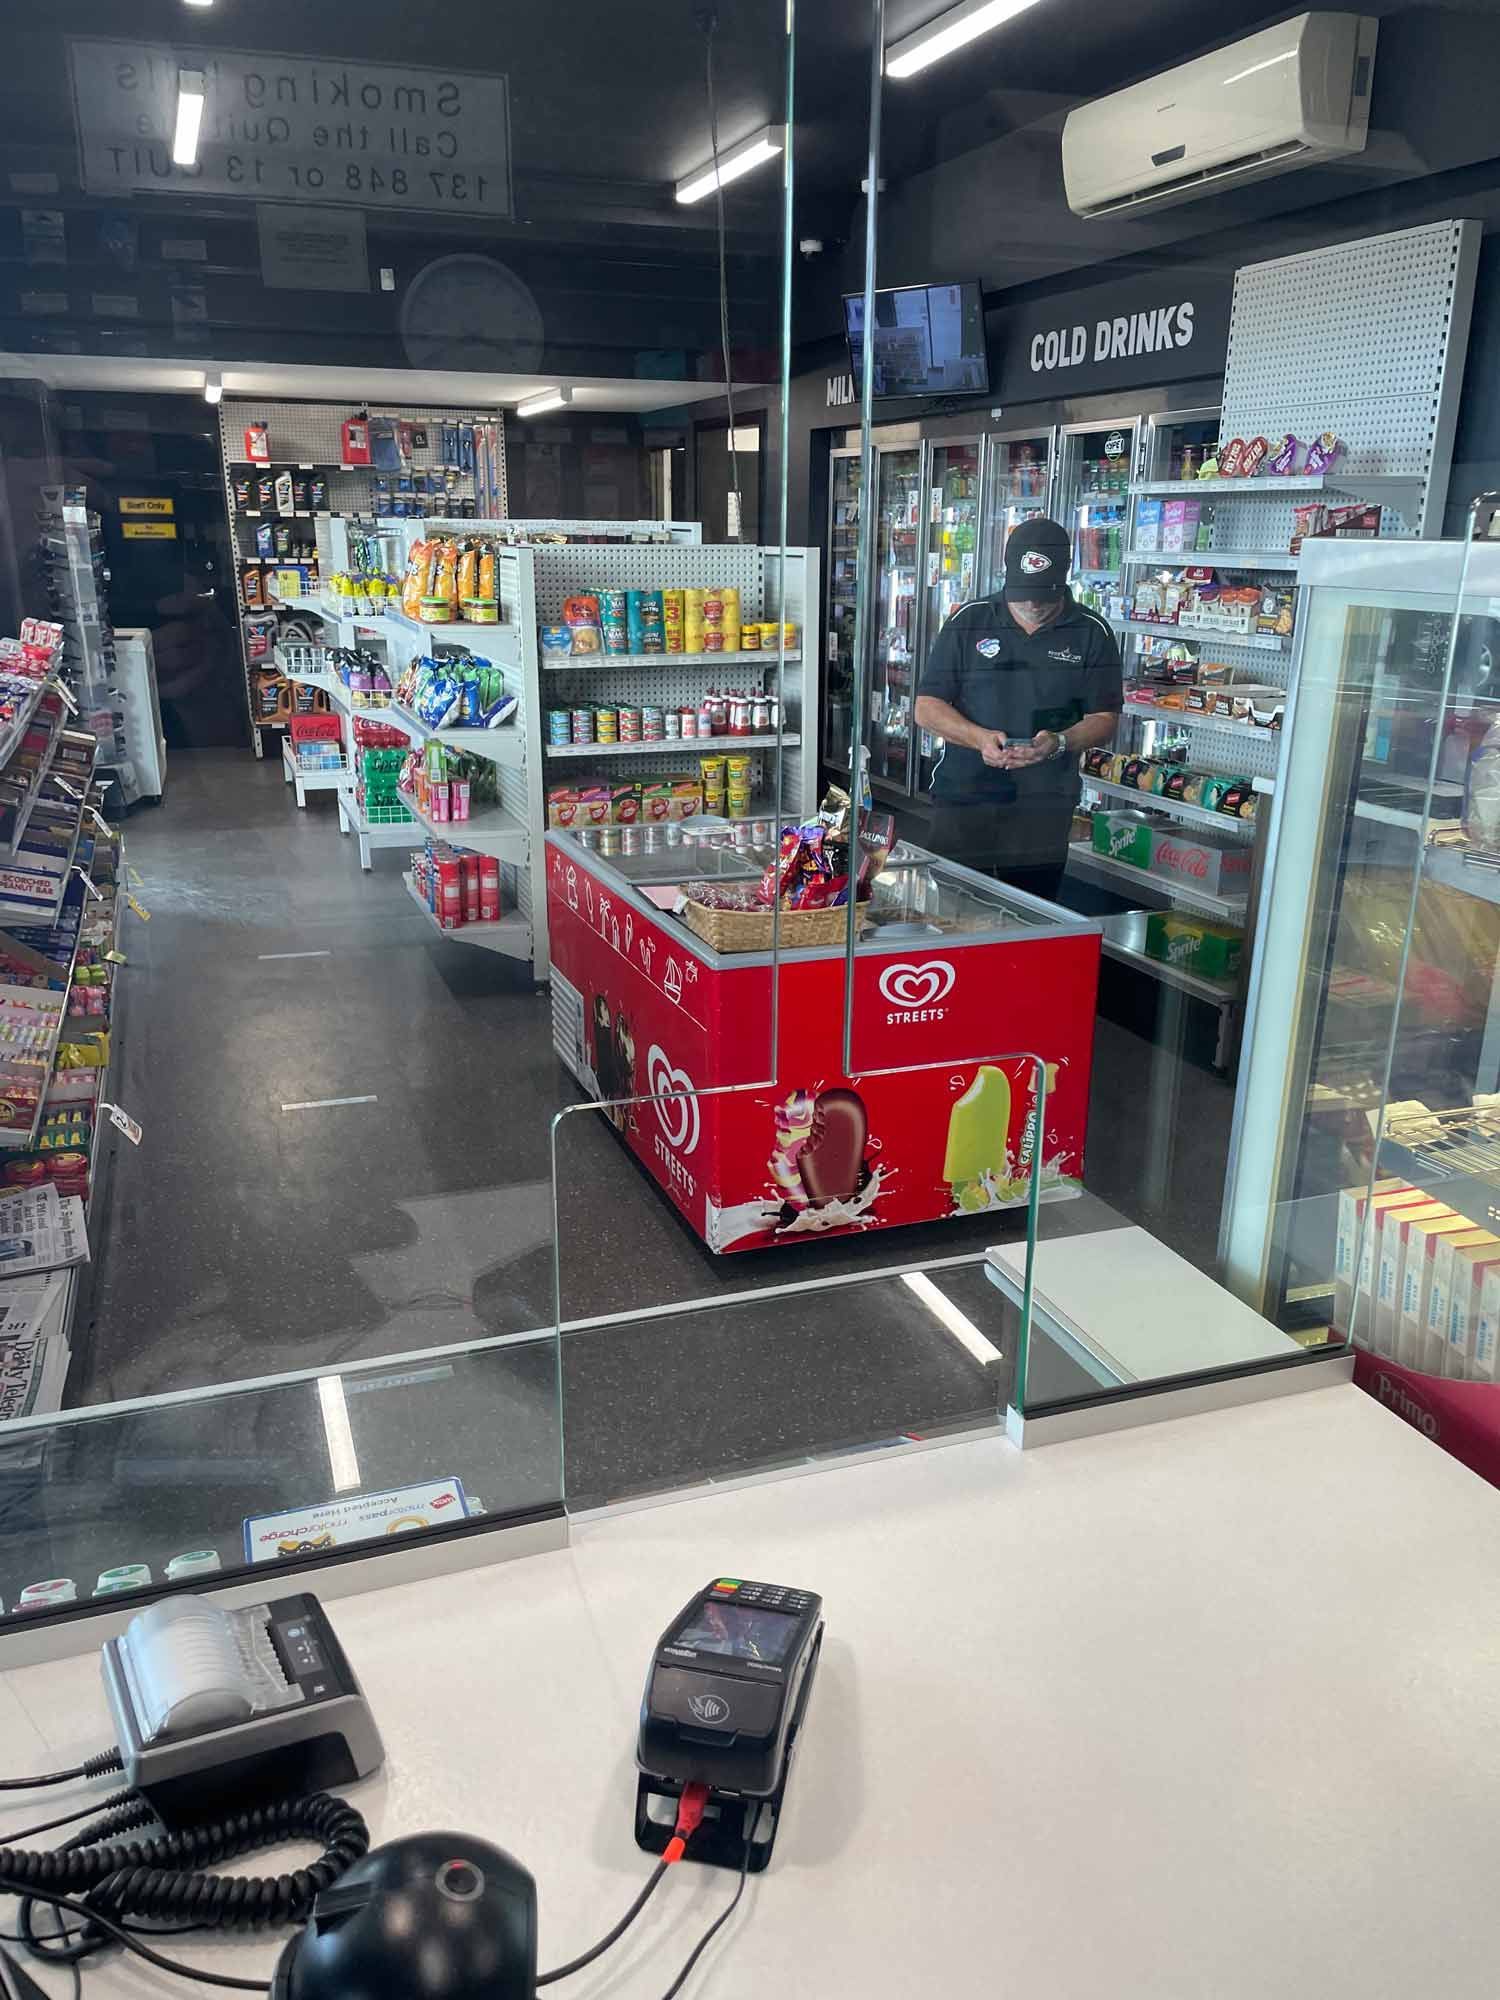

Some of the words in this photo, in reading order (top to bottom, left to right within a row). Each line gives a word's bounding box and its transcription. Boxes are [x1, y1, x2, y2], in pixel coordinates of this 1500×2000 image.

[1029, 325, 1087, 373] COLD
[1093, 301, 1194, 363] DRINKS
[147, 501, 165, 511] Only
[1108, 827, 1137, 856] Sprite
[1155, 839, 1212, 880] Coca-Cola
[1166, 935, 1201, 962] Sprite
[886, 1008, 945, 1026] STREETS
[653, 1135, 694, 1196] STREETS
[5, 1340, 36, 1380] Daily
[1377, 1374, 1437, 1436] Primo
[312, 1509, 341, 1520] Here
[342, 1496, 400, 1514] Accepted
[358, 1503, 425, 1522] motorpass
[258, 1519, 349, 1543] motorcharge
